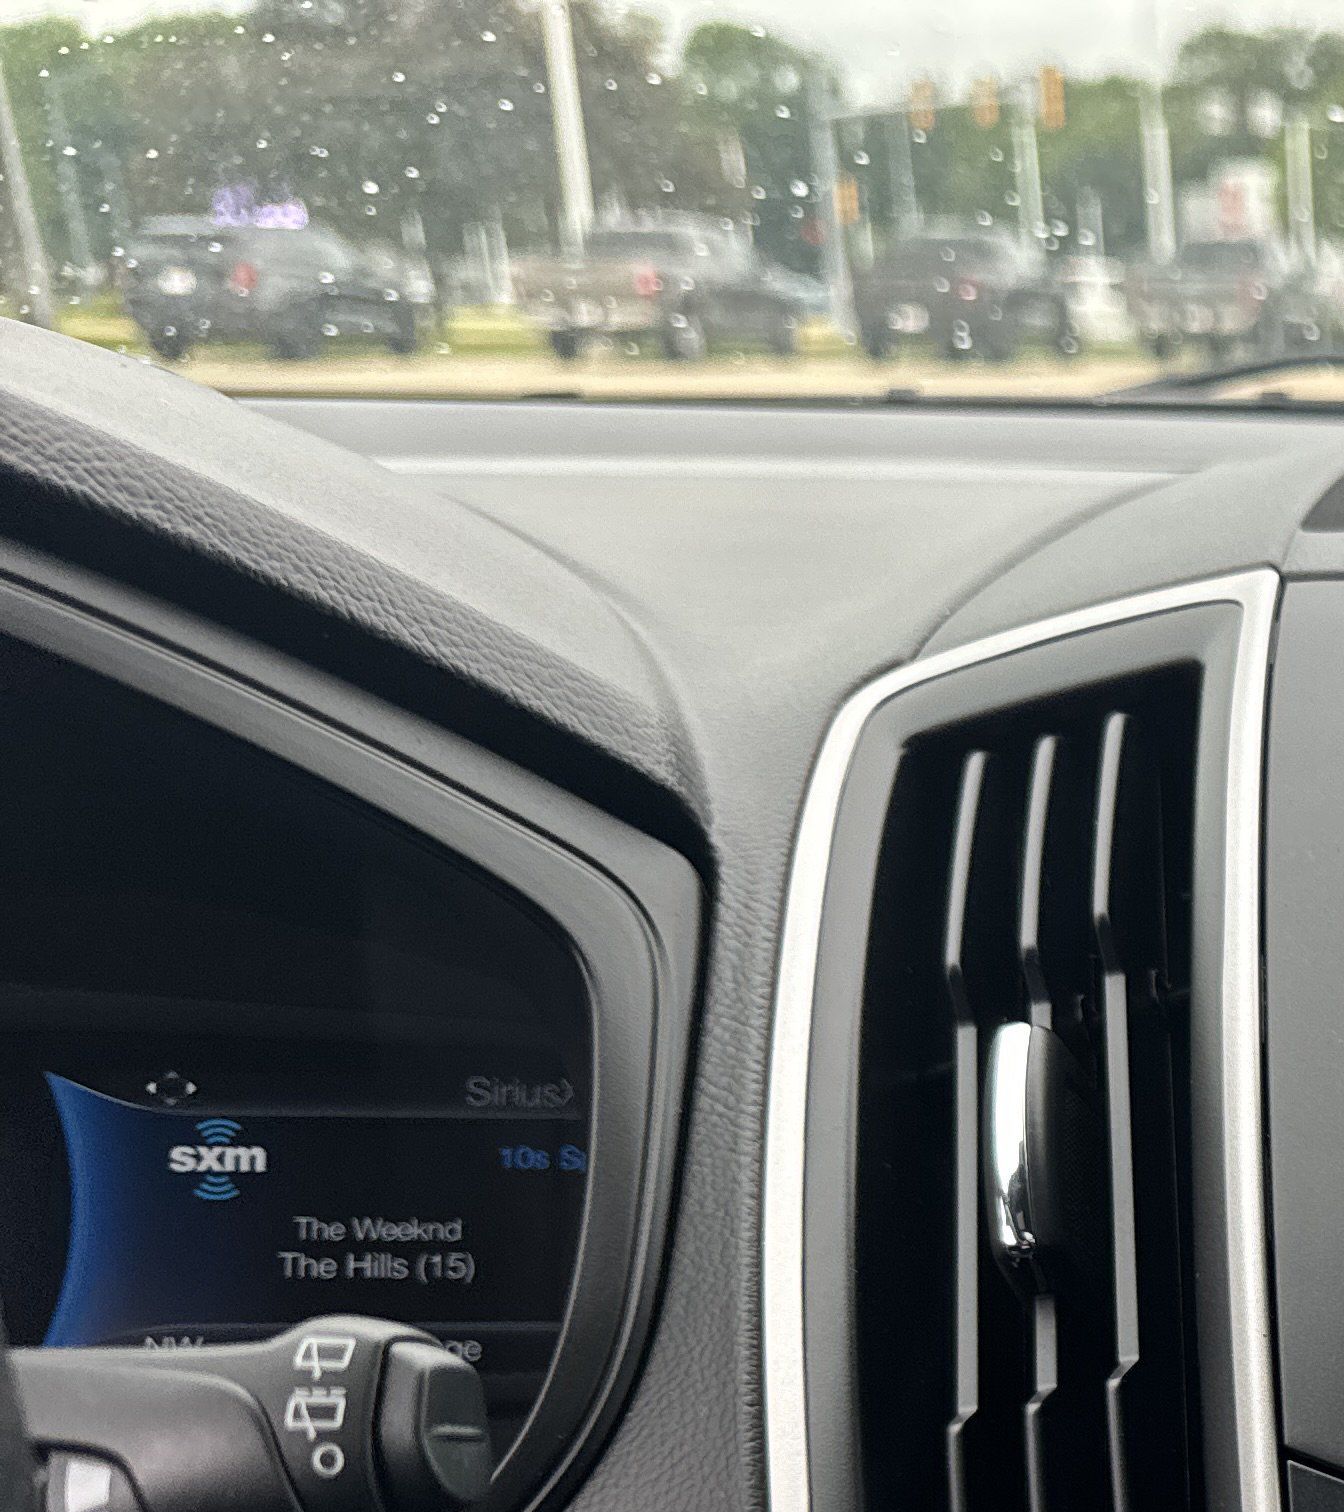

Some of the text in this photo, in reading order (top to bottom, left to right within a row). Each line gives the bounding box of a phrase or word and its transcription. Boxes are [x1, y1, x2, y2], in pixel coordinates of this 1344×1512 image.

[168, 1145, 267, 1173] sxm
[499, 1144, 550, 1170] 10s
[292, 1215, 463, 1243] The Weeknd
[276, 1251, 477, 1285] The Hills (15)
